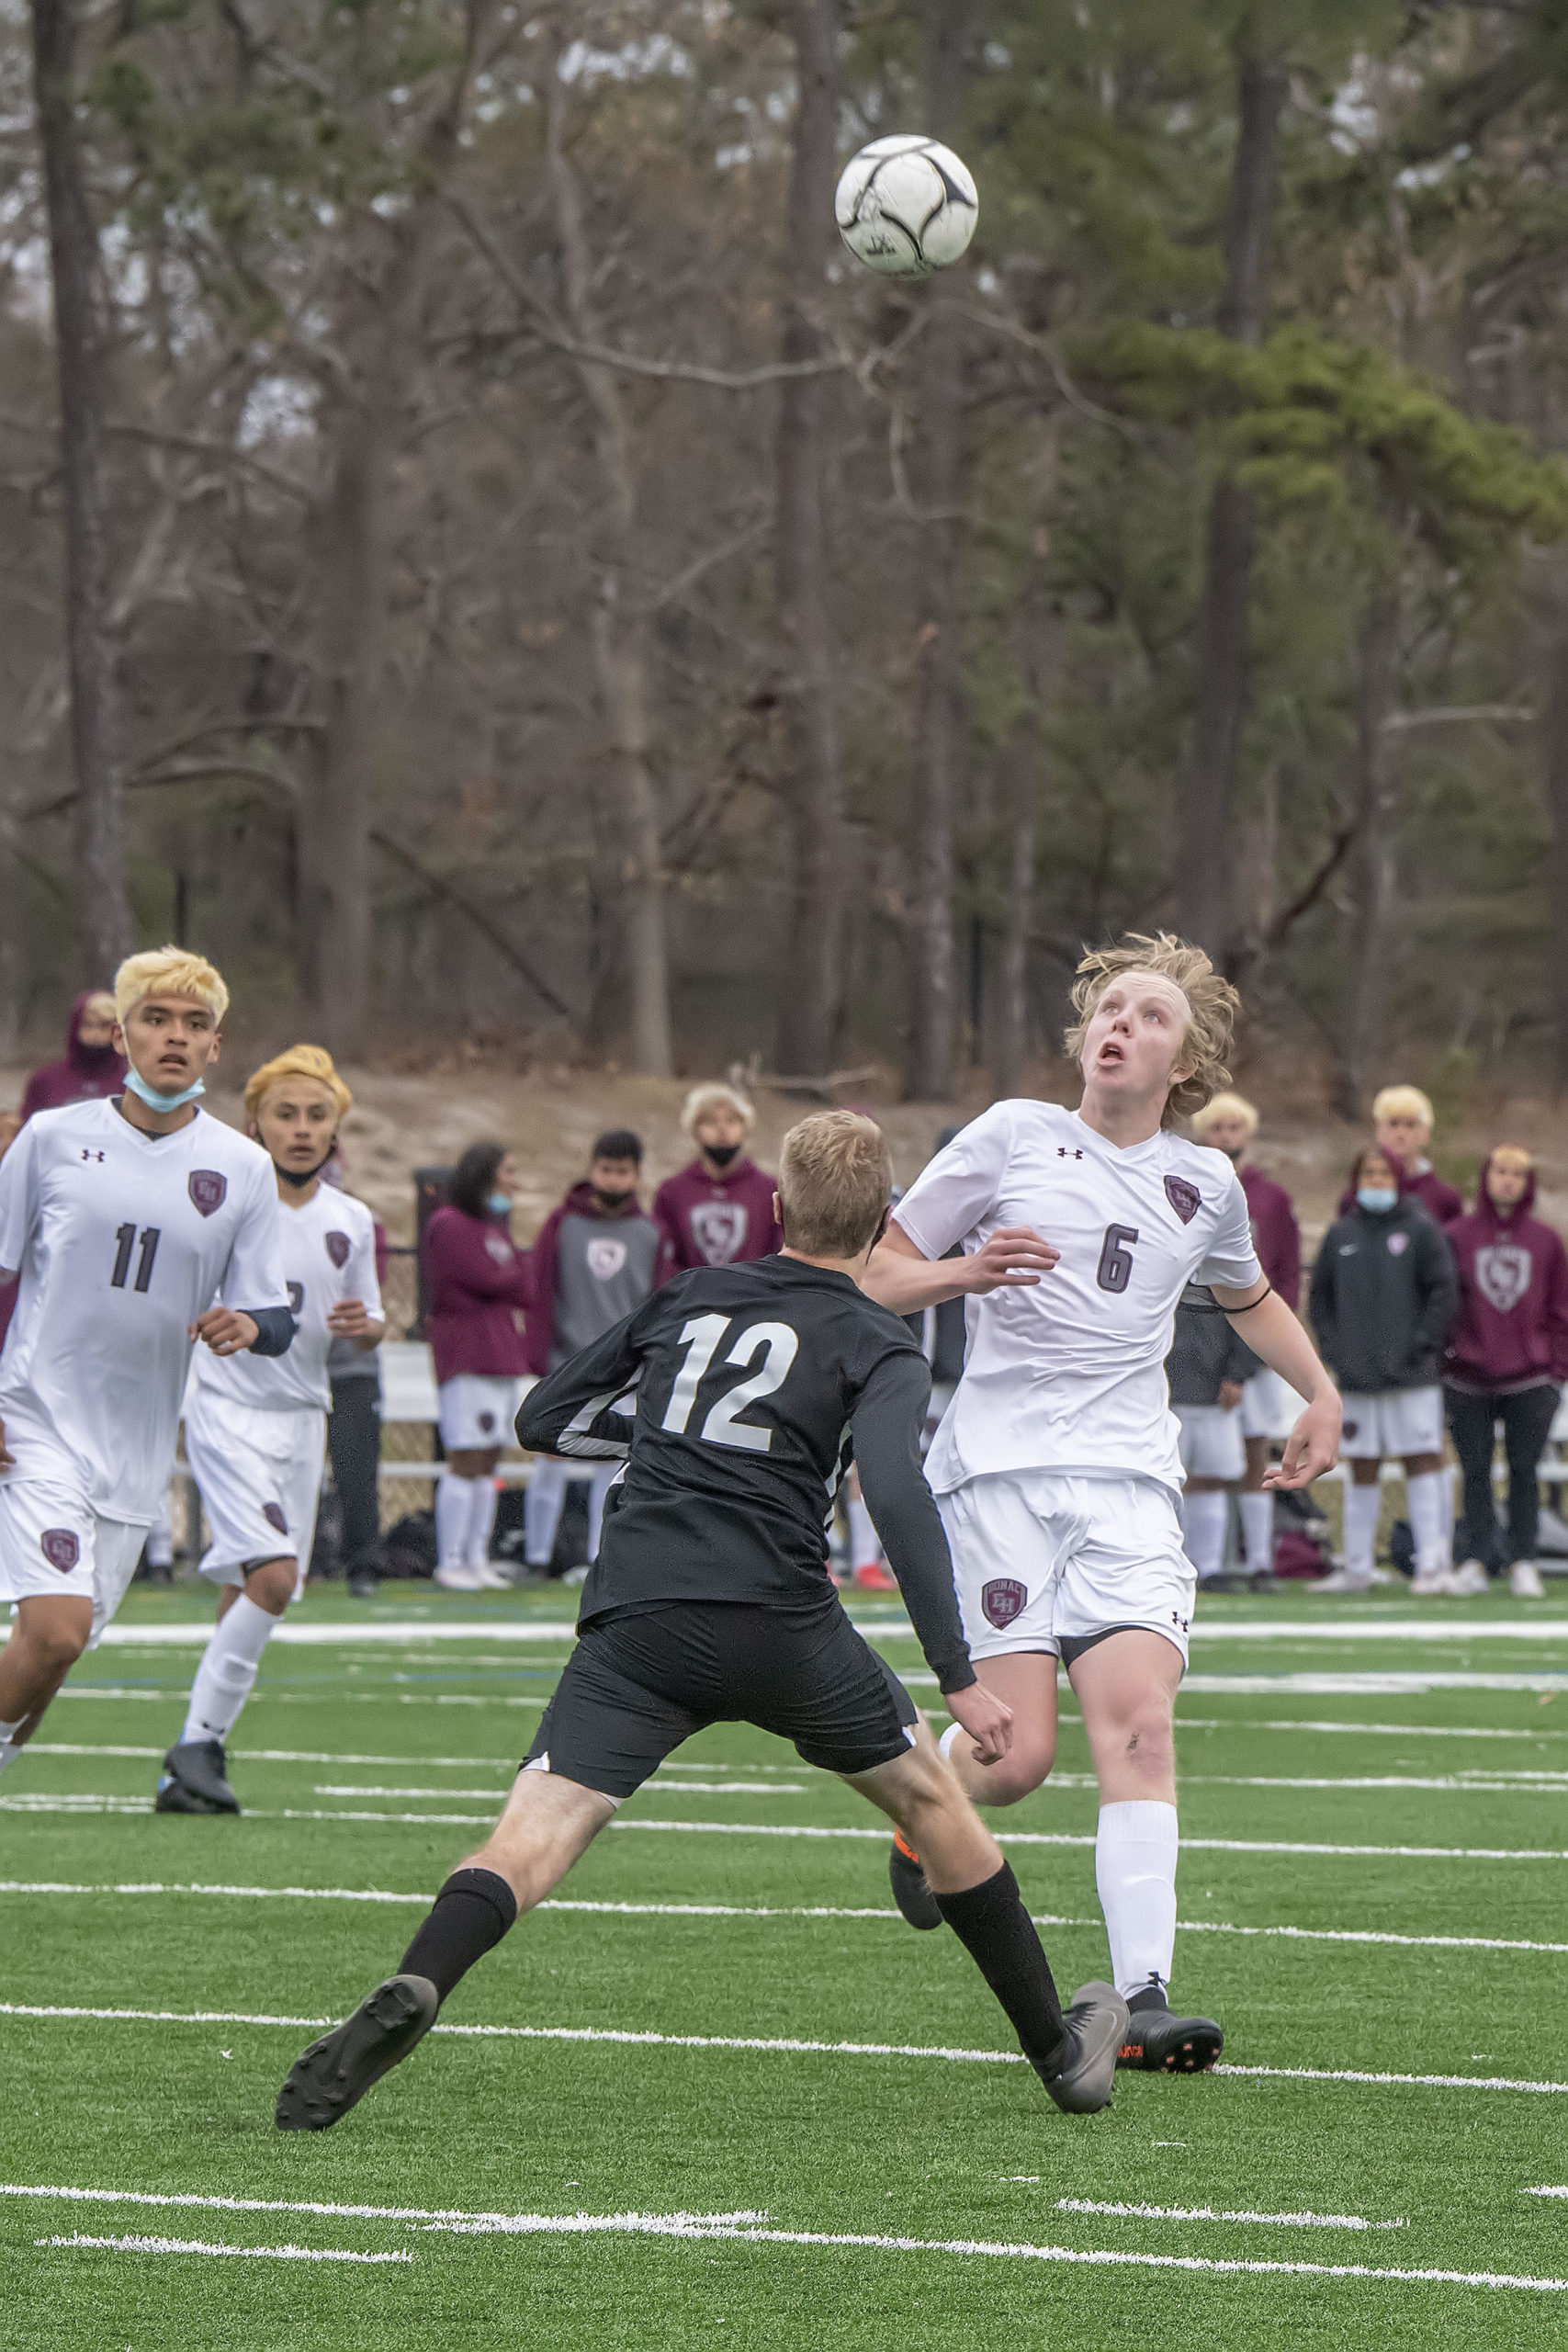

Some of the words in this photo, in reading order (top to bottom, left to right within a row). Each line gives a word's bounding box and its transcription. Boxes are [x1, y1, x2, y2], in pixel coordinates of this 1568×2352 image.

[110, 1222, 161, 1293] 11
[1096, 1222, 1139, 1294] 6
[660, 1313, 799, 1453] 12
